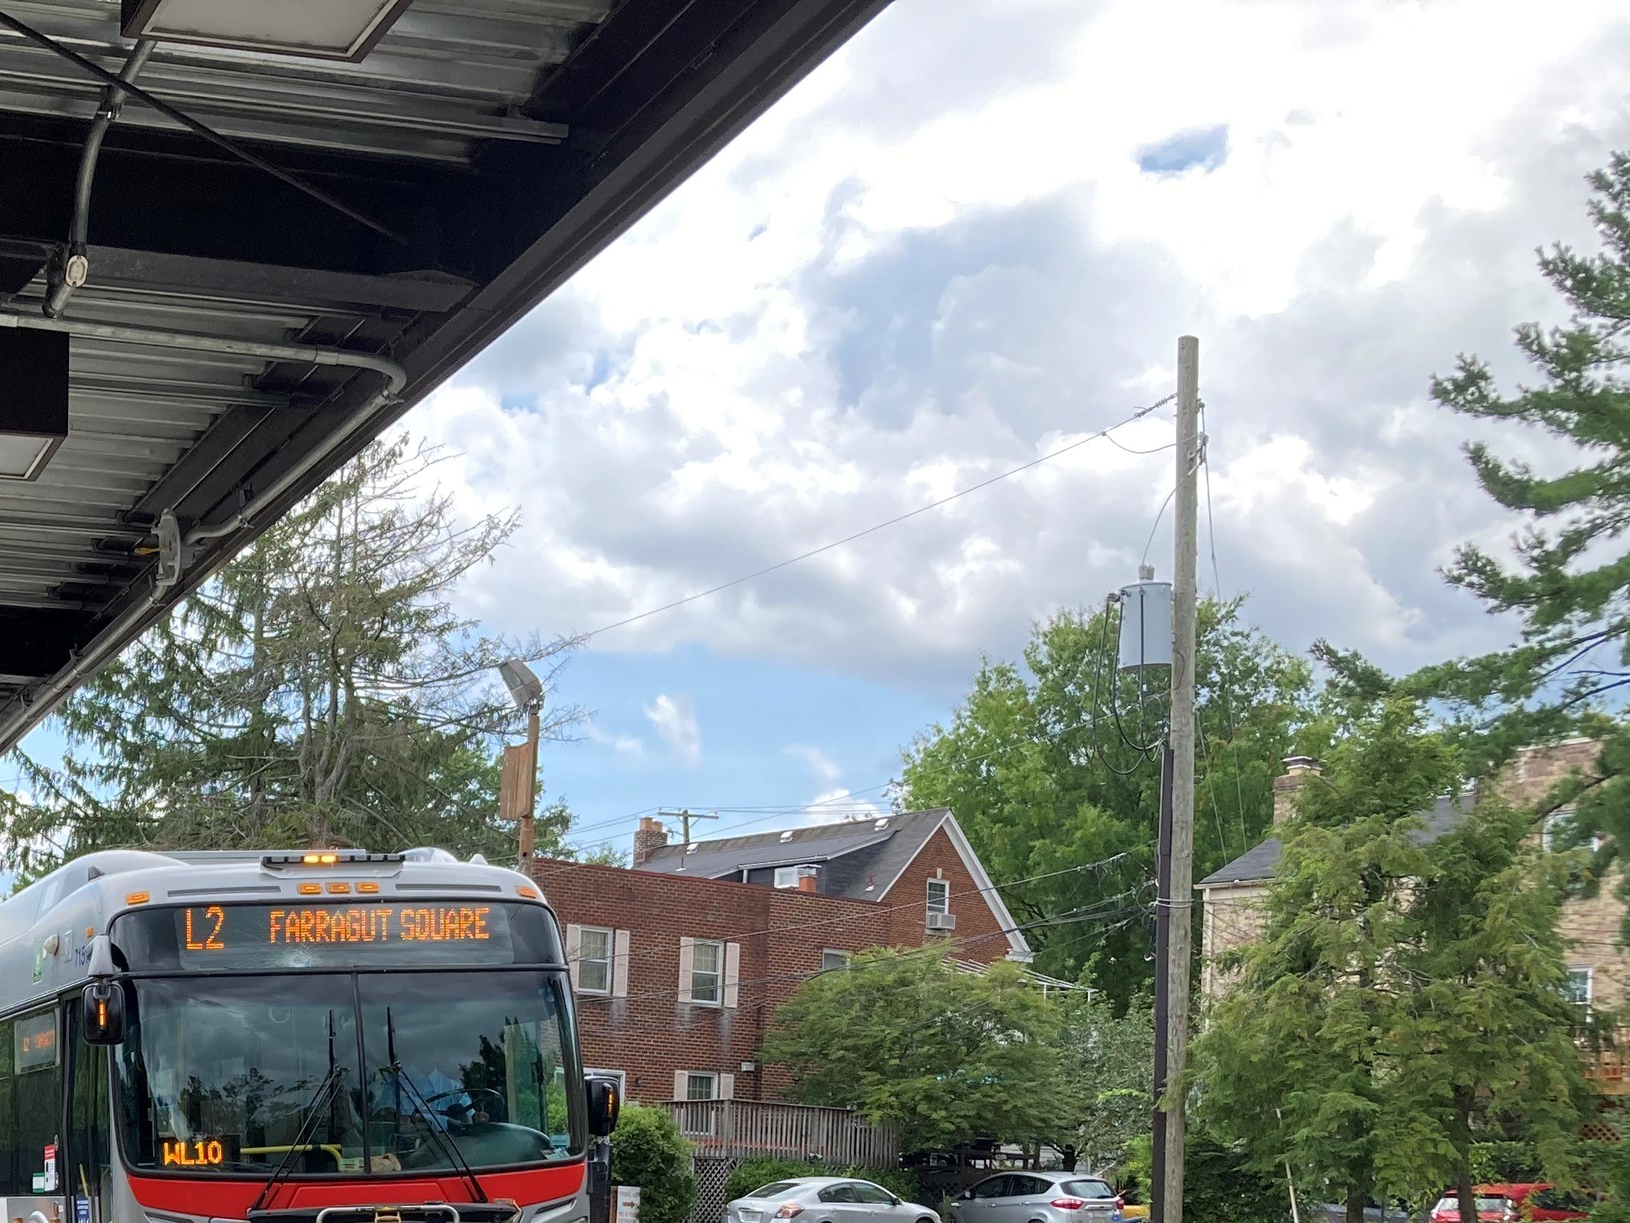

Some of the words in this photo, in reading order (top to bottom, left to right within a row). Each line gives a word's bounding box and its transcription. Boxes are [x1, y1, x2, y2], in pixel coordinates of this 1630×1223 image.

[184, 906, 225, 950] L2
[270, 909, 393, 943] FARRAGUT
[400, 907, 489, 941] SQUARE
[163, 1140, 222, 1166] WL10
